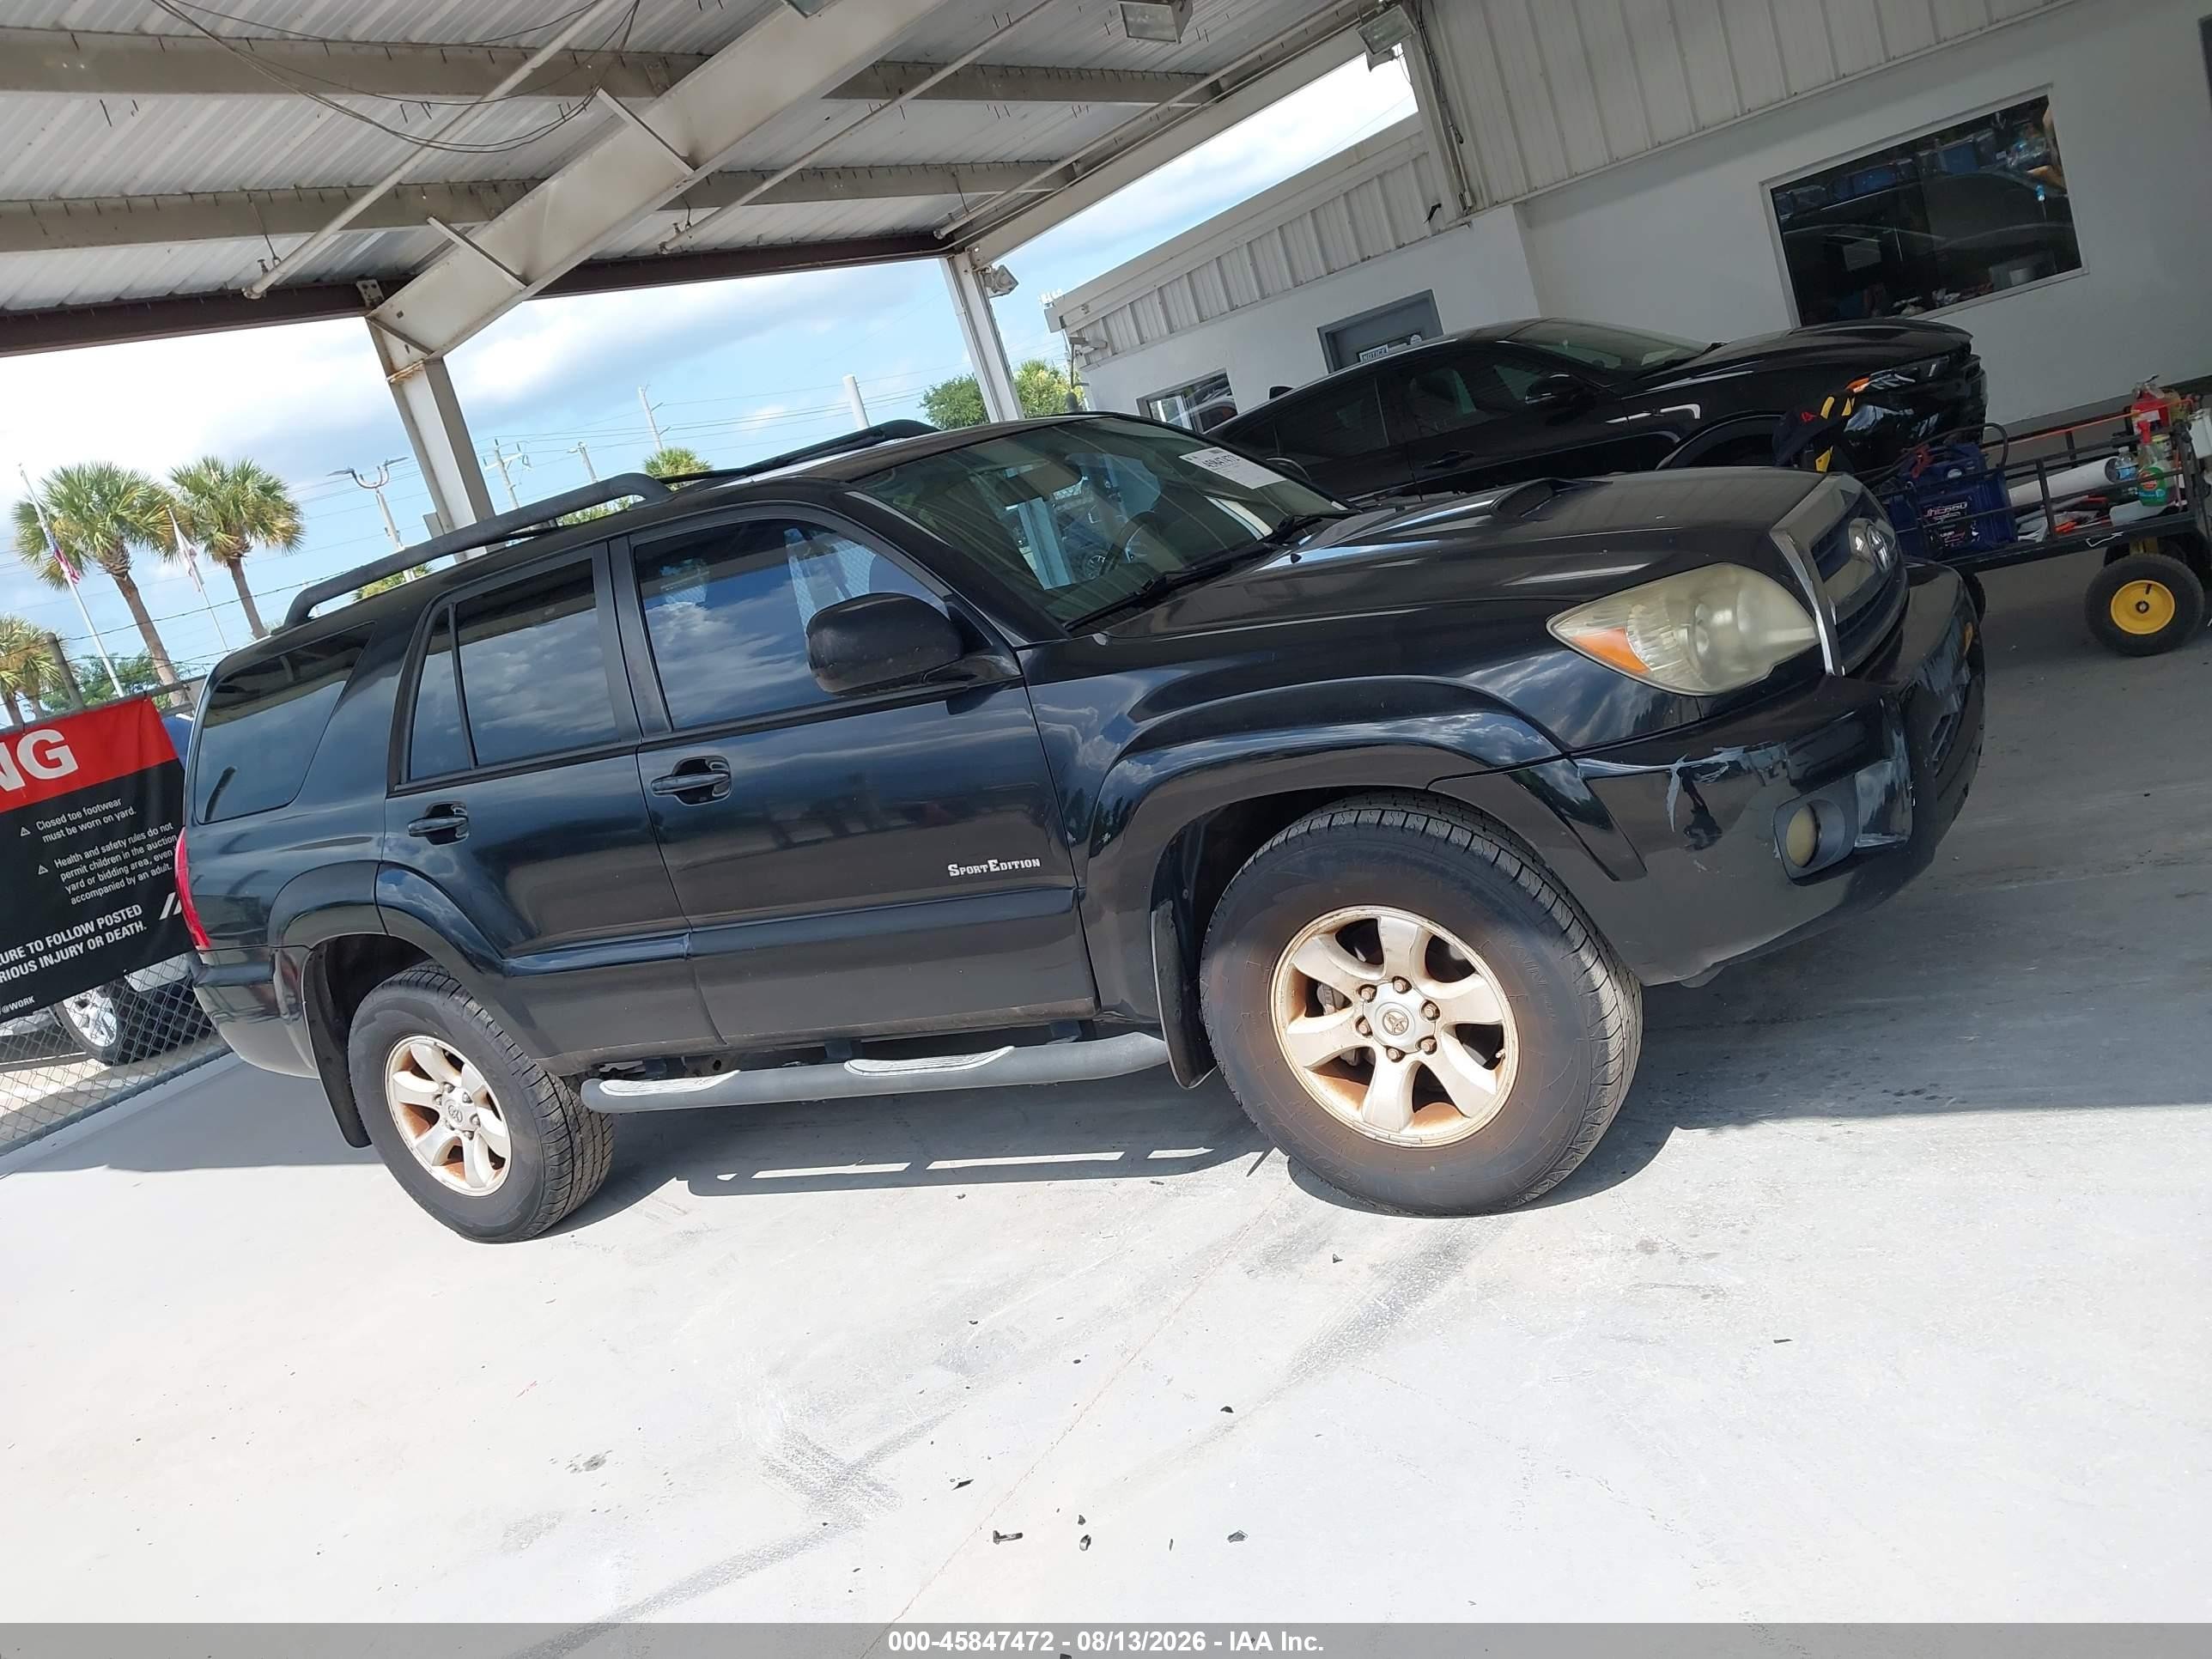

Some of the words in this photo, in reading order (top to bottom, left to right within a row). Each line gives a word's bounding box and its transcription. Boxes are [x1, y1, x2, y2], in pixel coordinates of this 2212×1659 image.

[36, 814, 67, 831] Closed
[68, 811, 82, 822] toe
[82, 798, 122, 816] footwear
[42, 829, 65, 842] must
[67, 823, 77, 835] be
[79, 817, 101, 831] worn
[103, 813, 113, 823] on
[115, 805, 137, 823] yard.
[53, 852, 82, 868] Health
[83, 845, 100, 859] and
[100, 837, 127, 854] safety
[128, 830, 147, 844] rules
[148, 826, 158, 837] do
[160, 821, 173, 834] not
[59, 865, 88, 882] permit
[88, 853, 122, 871] children
[122, 848, 131, 860] in
[131, 843, 144, 856] the
[146, 834, 178, 850] auction
[64, 878, 86, 894] yard
[87, 873, 97, 885] or
[97, 864, 130, 882] bidding
[130, 856, 152, 871] area,
[153, 849, 173, 862] even
[70, 879, 125, 904] accompanied
[126, 874, 137, 885] by
[137, 871, 149, 881] an
[150, 862, 173, 876] adult.
[26, 939, 44, 955] TO
[45, 920, 95, 948] FOLLOW
[96, 904, 143, 929] POSTED
[40, 942, 85, 969] INJURY
[87, 936, 106, 951] OR
[106, 920, 147, 944] DEATH.
